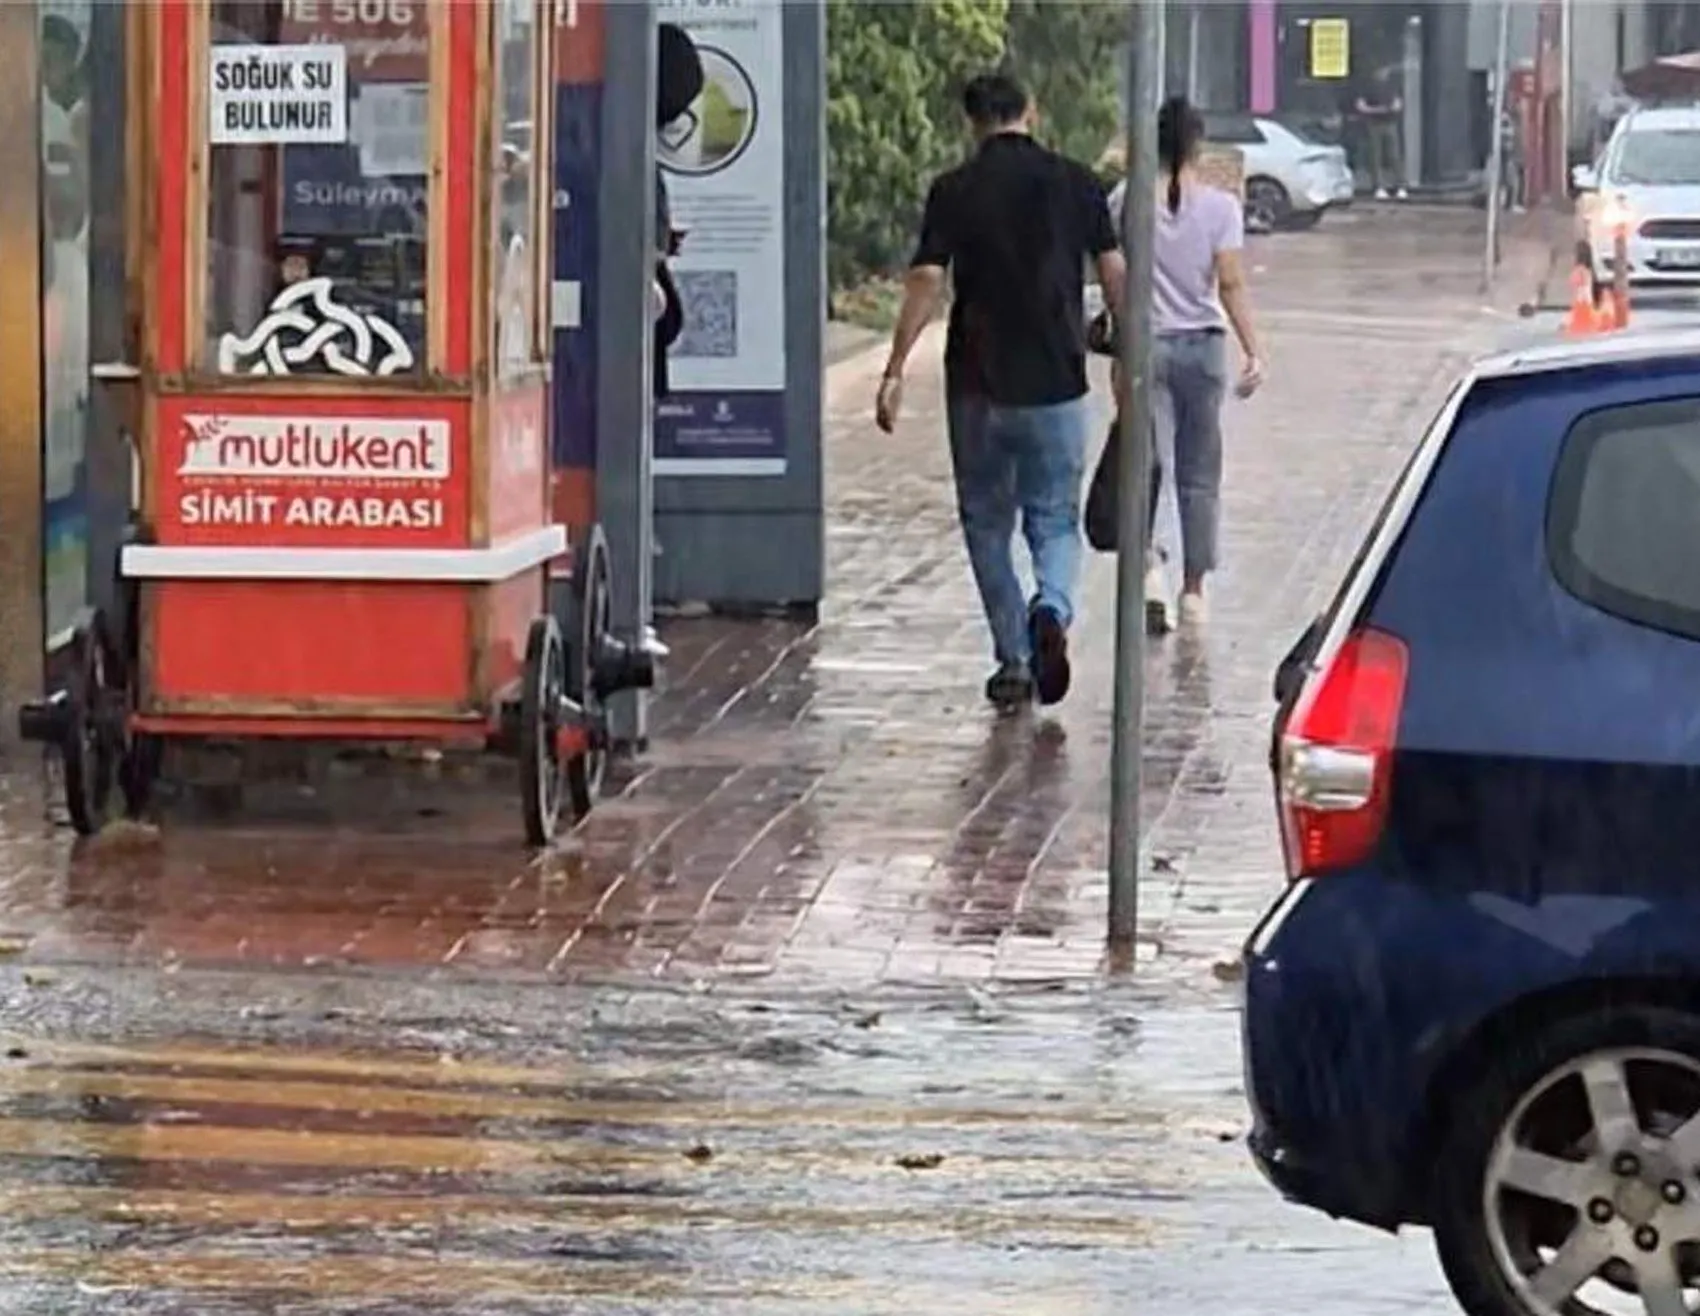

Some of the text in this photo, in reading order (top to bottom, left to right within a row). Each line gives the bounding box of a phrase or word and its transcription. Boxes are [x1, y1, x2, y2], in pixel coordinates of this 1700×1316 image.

[215, 55, 333, 91] SOĞUK SU
[225, 101, 333, 131] BULUNUR
[218, 423, 436, 470] mutlukent
[180, 487, 443, 528] SİMİT ARABASI
